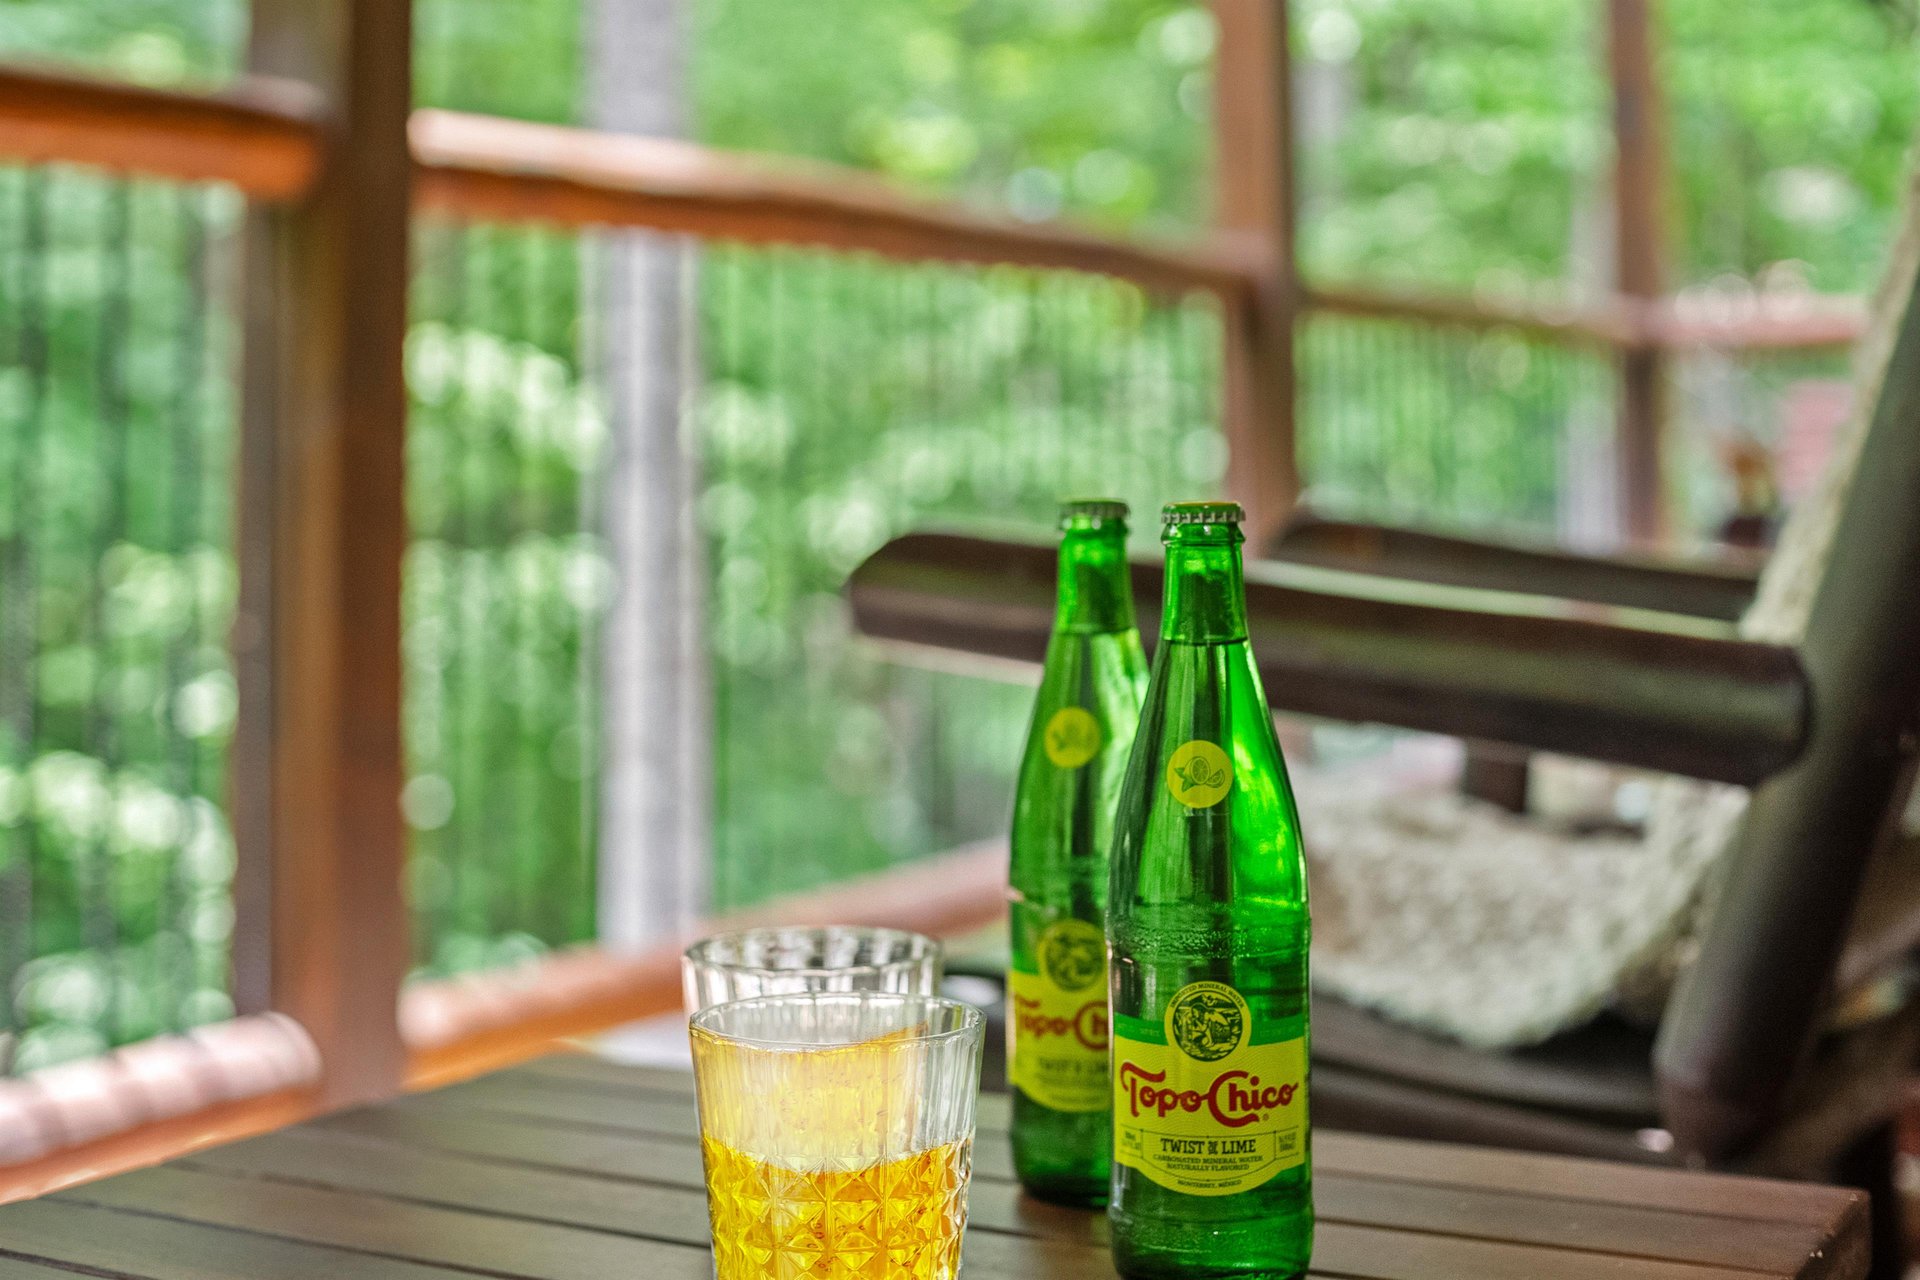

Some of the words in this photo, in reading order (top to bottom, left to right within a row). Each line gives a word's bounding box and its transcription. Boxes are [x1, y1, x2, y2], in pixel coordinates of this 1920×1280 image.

[1198, 983, 1228, 992] MINERAL
[1228, 990, 1245, 1008] WATER
[1120, 1061, 1203, 1118] Topo
[1206, 1070, 1299, 1128] Chico
[1161, 1138, 1205, 1155] TWIST
[1221, 1139, 1256, 1154] LIME
[1166, 1163, 1209, 1171] NATURALLY
[1211, 1163, 1249, 1171] FLAVORED
[1238, 1155, 1263, 1163] WATER
